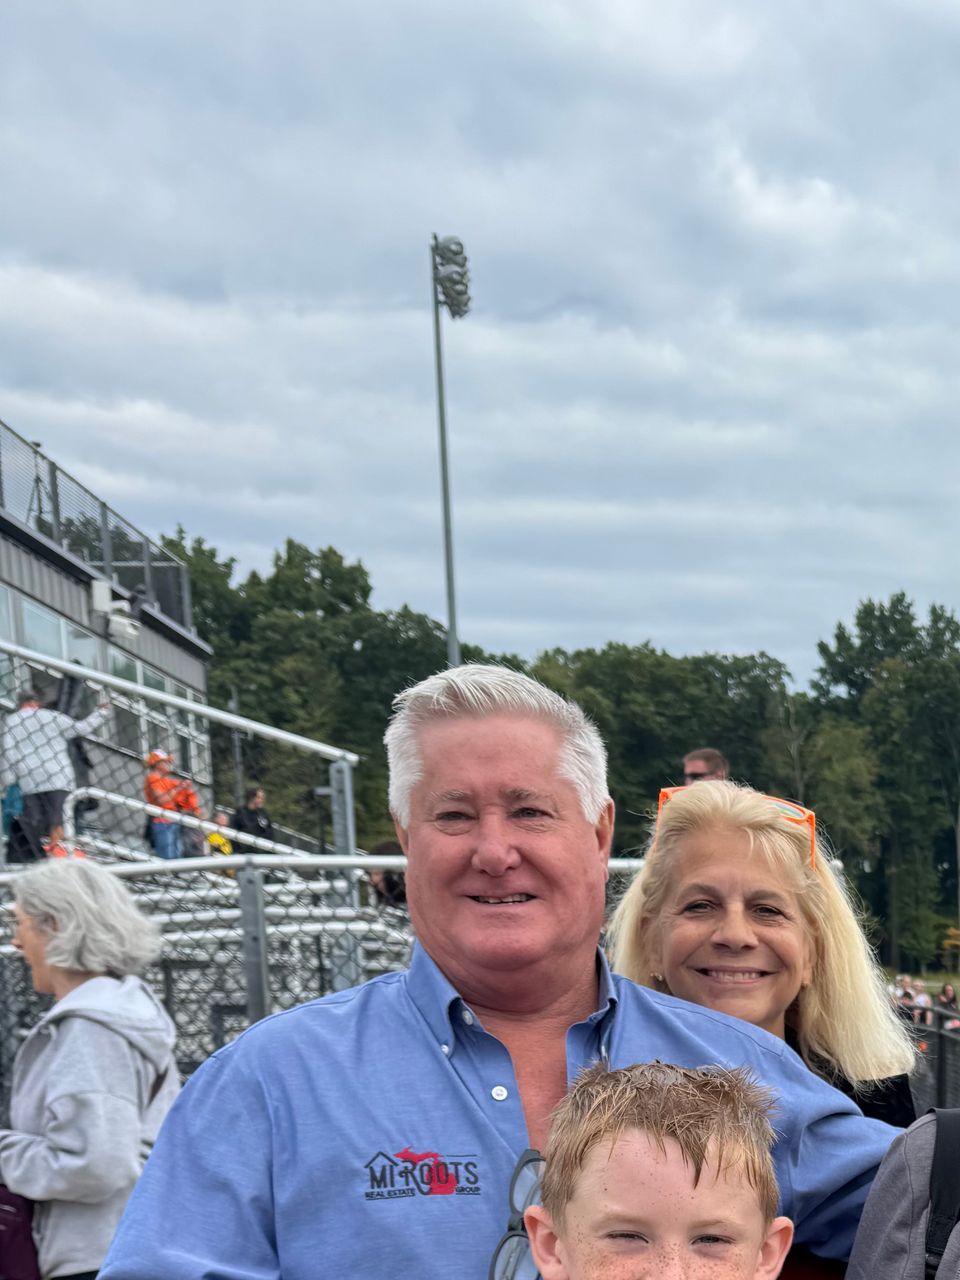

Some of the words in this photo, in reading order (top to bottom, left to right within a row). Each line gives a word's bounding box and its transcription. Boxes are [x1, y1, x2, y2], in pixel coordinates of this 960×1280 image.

[365, 1190, 385, 1199] REAL
[387, 1187, 416, 1197] ESTATE
[455, 1186, 481, 1194] GROUP
